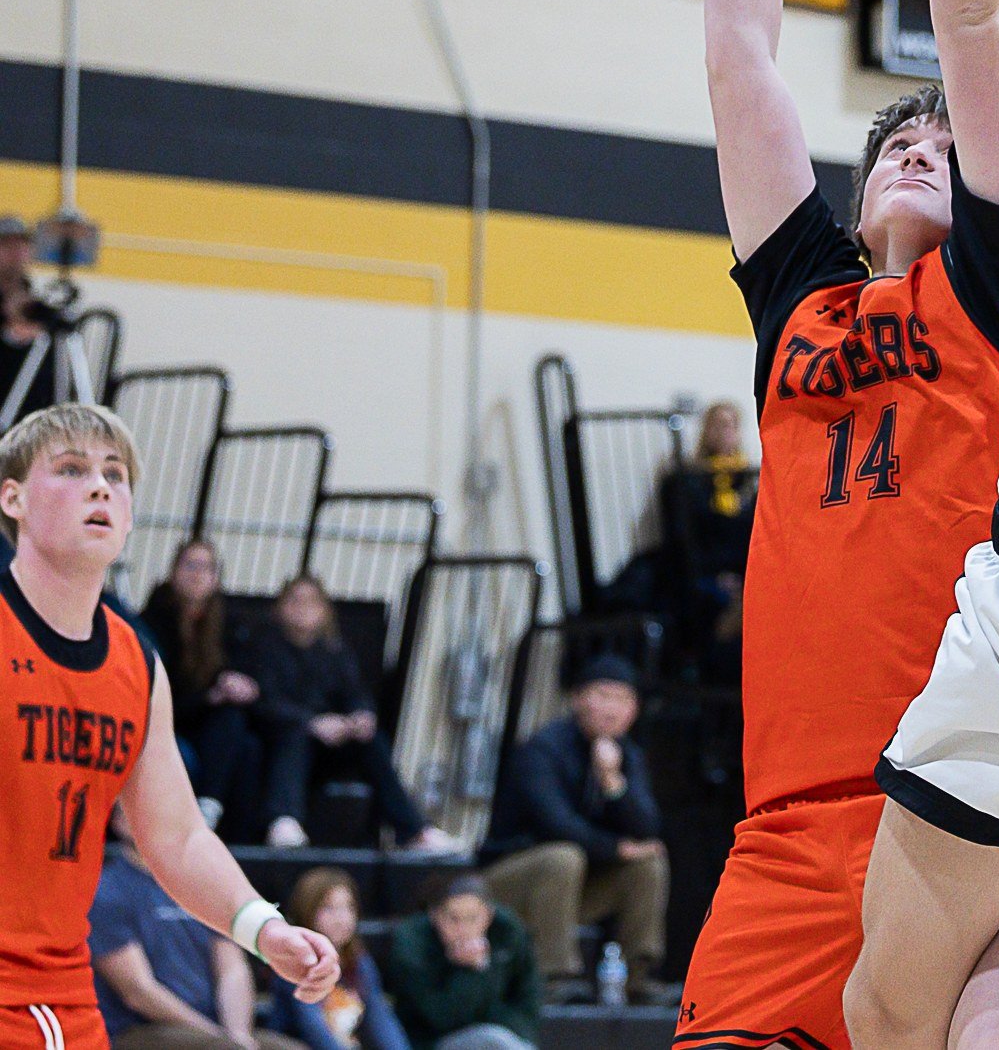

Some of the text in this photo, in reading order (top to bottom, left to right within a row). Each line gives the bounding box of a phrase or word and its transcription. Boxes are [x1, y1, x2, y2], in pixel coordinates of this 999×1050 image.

[776, 310, 942, 401] TGERS
[820, 401, 901, 509] 14
[16, 703, 136, 777] TIGERS
[48, 779, 91, 863] 11
